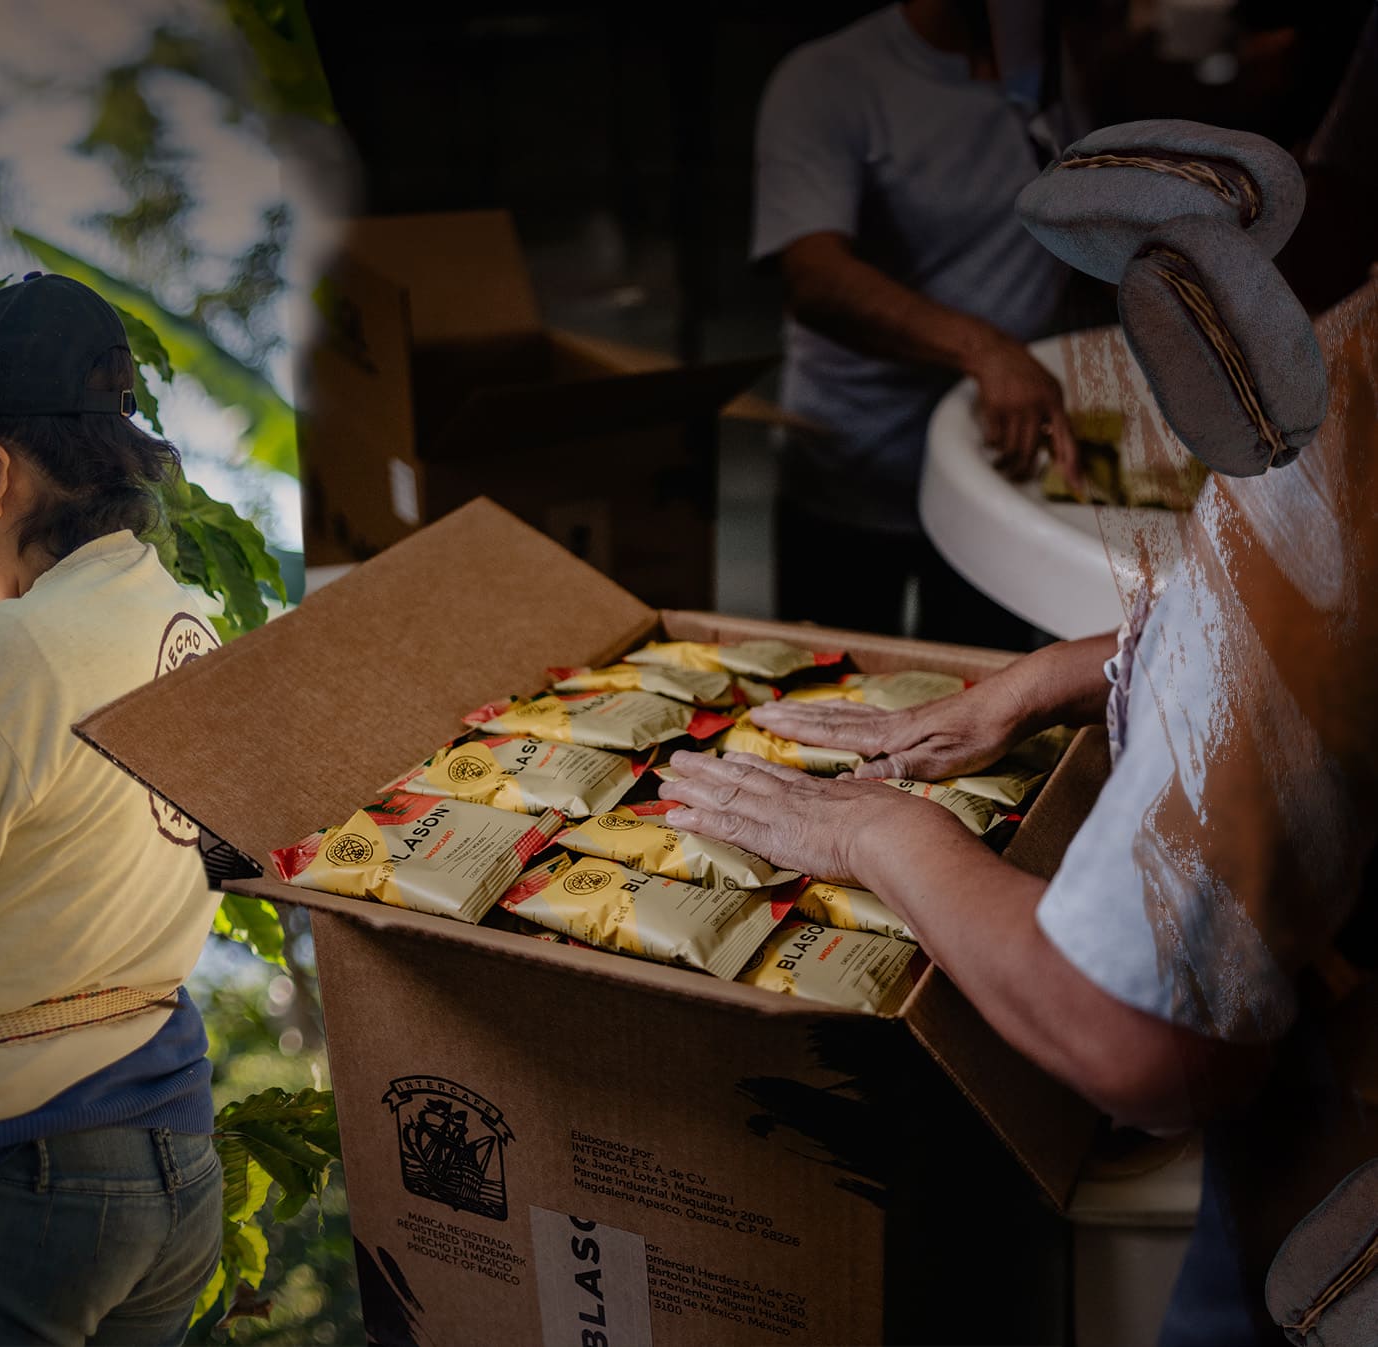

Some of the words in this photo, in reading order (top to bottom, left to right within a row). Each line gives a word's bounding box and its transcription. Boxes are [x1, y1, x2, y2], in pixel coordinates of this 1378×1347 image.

[165, 629, 201, 672] ECHO
[571, 1130, 629, 1153] Elaborado
[573, 1154, 589, 1166] Av.
[633, 1170, 658, 1184] Lote
[674, 1181, 728, 1203] Manzana
[669, 1169, 683, 1179] de
[574, 1165, 612, 1183] Parque
[615, 1177, 668, 1200] Industrial
[671, 1192, 739, 1217] Maquilador
[740, 1210, 773, 1227] 2000
[575, 1177, 635, 1202] Magdalena
[638, 1196, 682, 1217] Apasco,
[397, 1219, 460, 1245] REGISTERED
[463, 1240, 526, 1267] TRADEMARK
[408, 1212, 445, 1231] MARCA
[447, 1224, 513, 1252] REGISTRADA
[413, 1234, 451, 1253] HECHO
[453, 1247, 468, 1258] EN
[407, 1242, 458, 1265] PRODUCT
[461, 1260, 475, 1271] OF
[646, 1254, 695, 1275] omercial
[698, 1267, 740, 1287] Herdez
[767, 1288, 783, 1299] de
[647, 1264, 689, 1283] Bartolo
[693, 1277, 755, 1304] Naucalpan
[660, 1279, 713, 1303] Poniente,
[716, 1295, 756, 1314] Miguel
[683, 1298, 698, 1308] de
